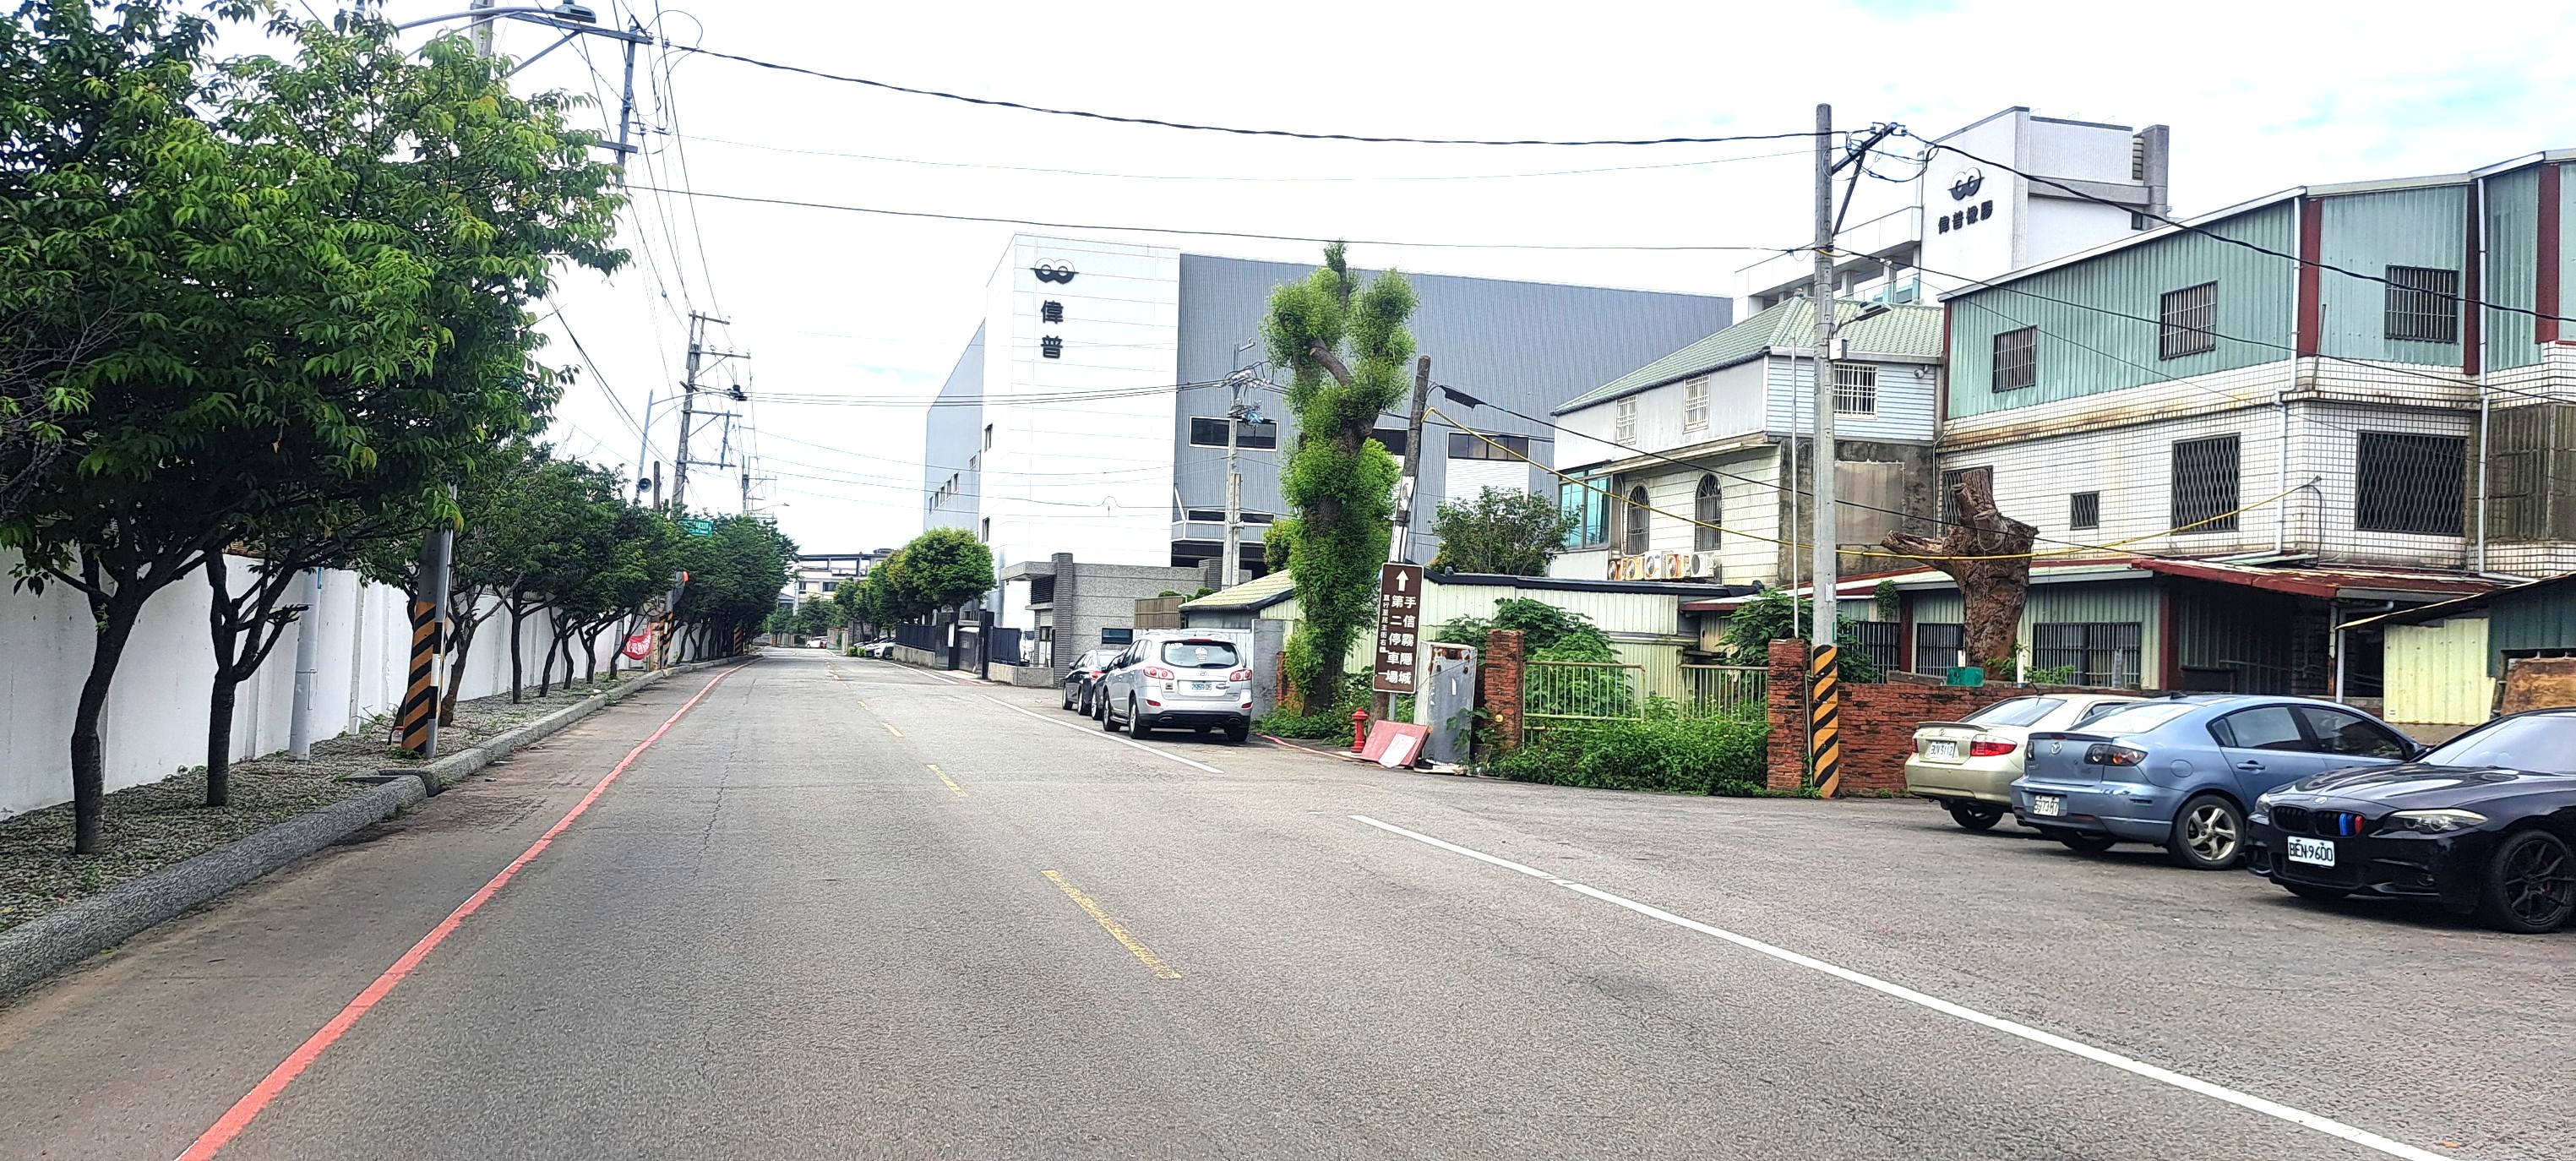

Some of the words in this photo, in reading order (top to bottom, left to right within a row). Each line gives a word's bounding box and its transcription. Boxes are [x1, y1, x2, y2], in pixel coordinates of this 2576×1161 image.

[1041, 300, 1064, 359] 偉普
[1386, 595, 1404, 684] 第二停車場
[1398, 596, 1417, 684] 手信霧隱城
[2289, 842, 2334, 862] BEN-9600
